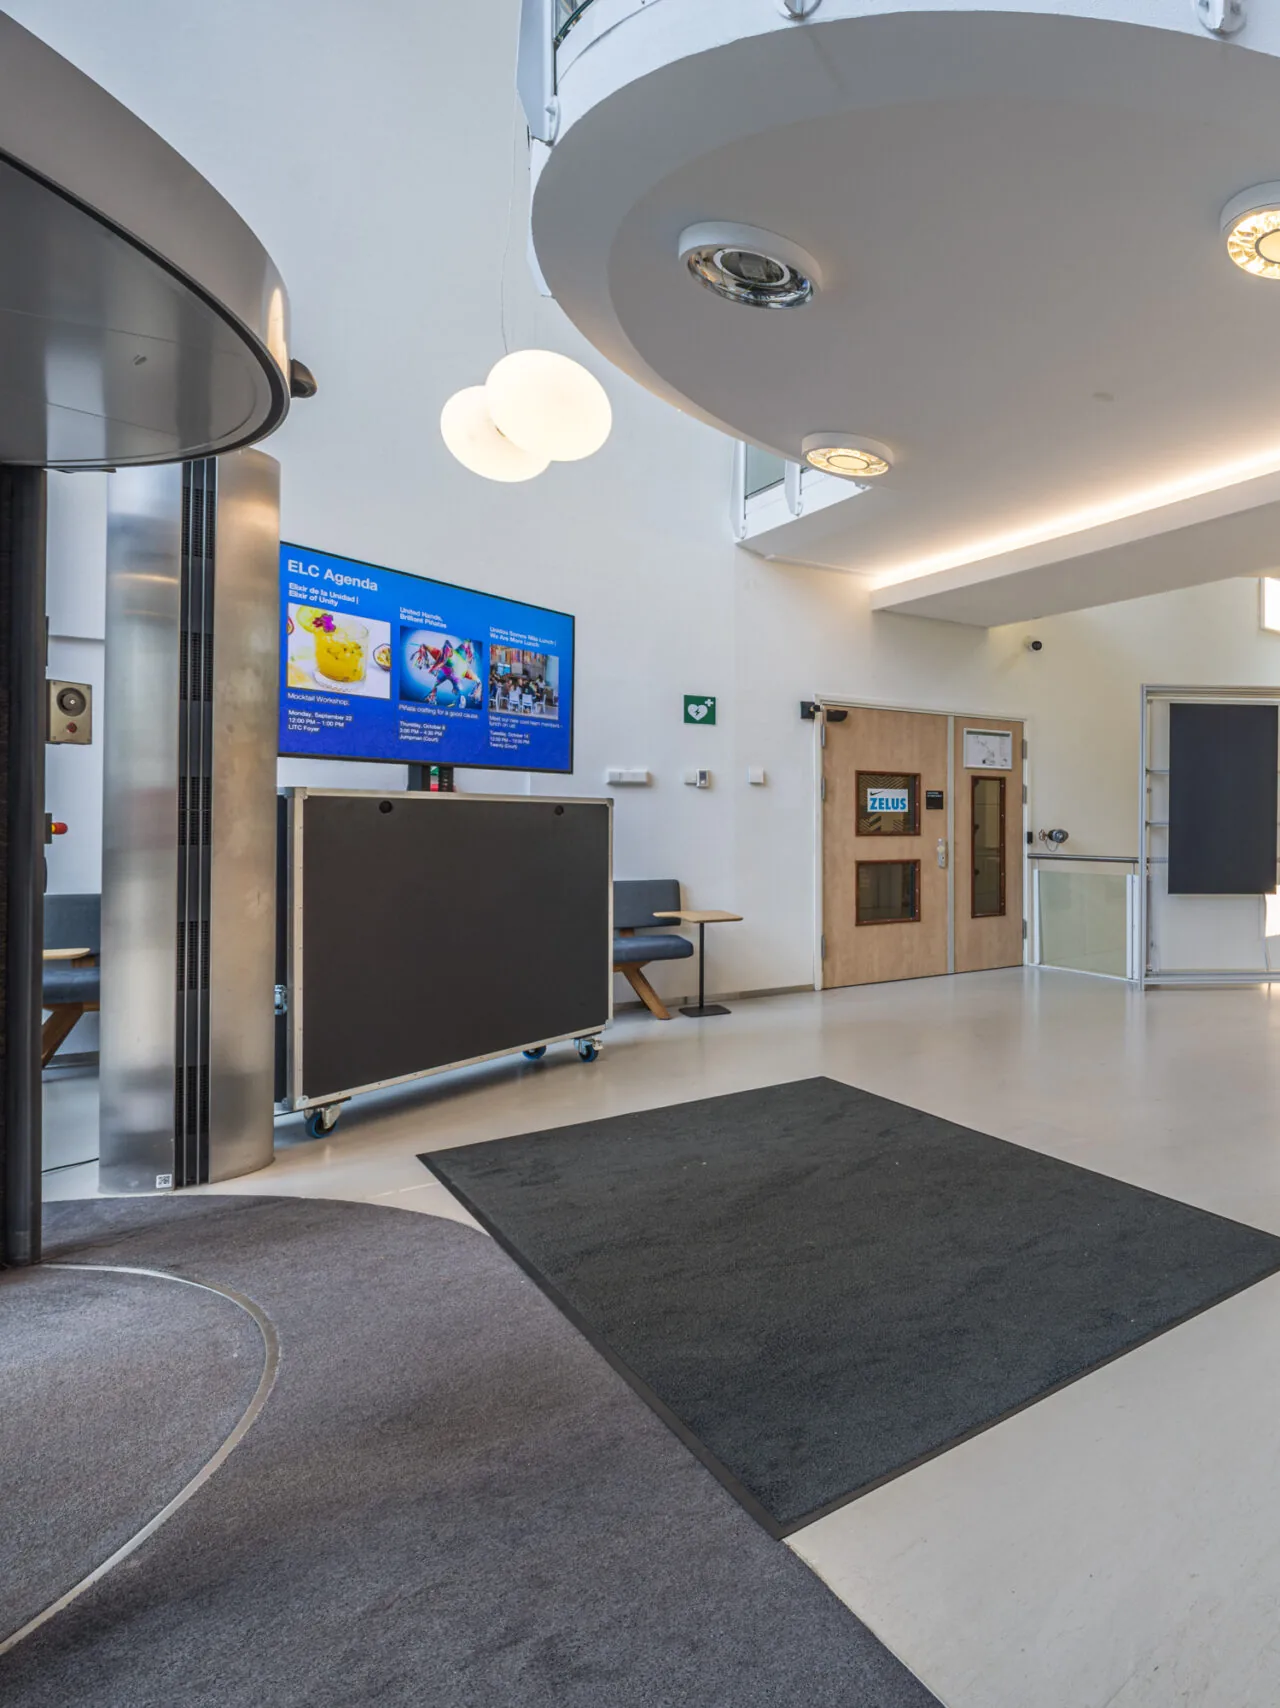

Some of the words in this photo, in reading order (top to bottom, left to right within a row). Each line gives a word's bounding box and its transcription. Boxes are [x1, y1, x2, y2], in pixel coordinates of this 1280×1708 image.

[288, 559, 319, 577] ELC
[324, 569, 378, 591] Agenda
[288, 590, 307, 599] Elixir
[319, 596, 338, 607] Unity
[289, 582, 307, 592] Elixir
[310, 587, 319, 595] de
[330, 592, 355, 602] Unidad
[288, 693, 315, 701] Mocktail
[315, 712, 344, 720] September
[870, 797, 906, 810] ZELUS
